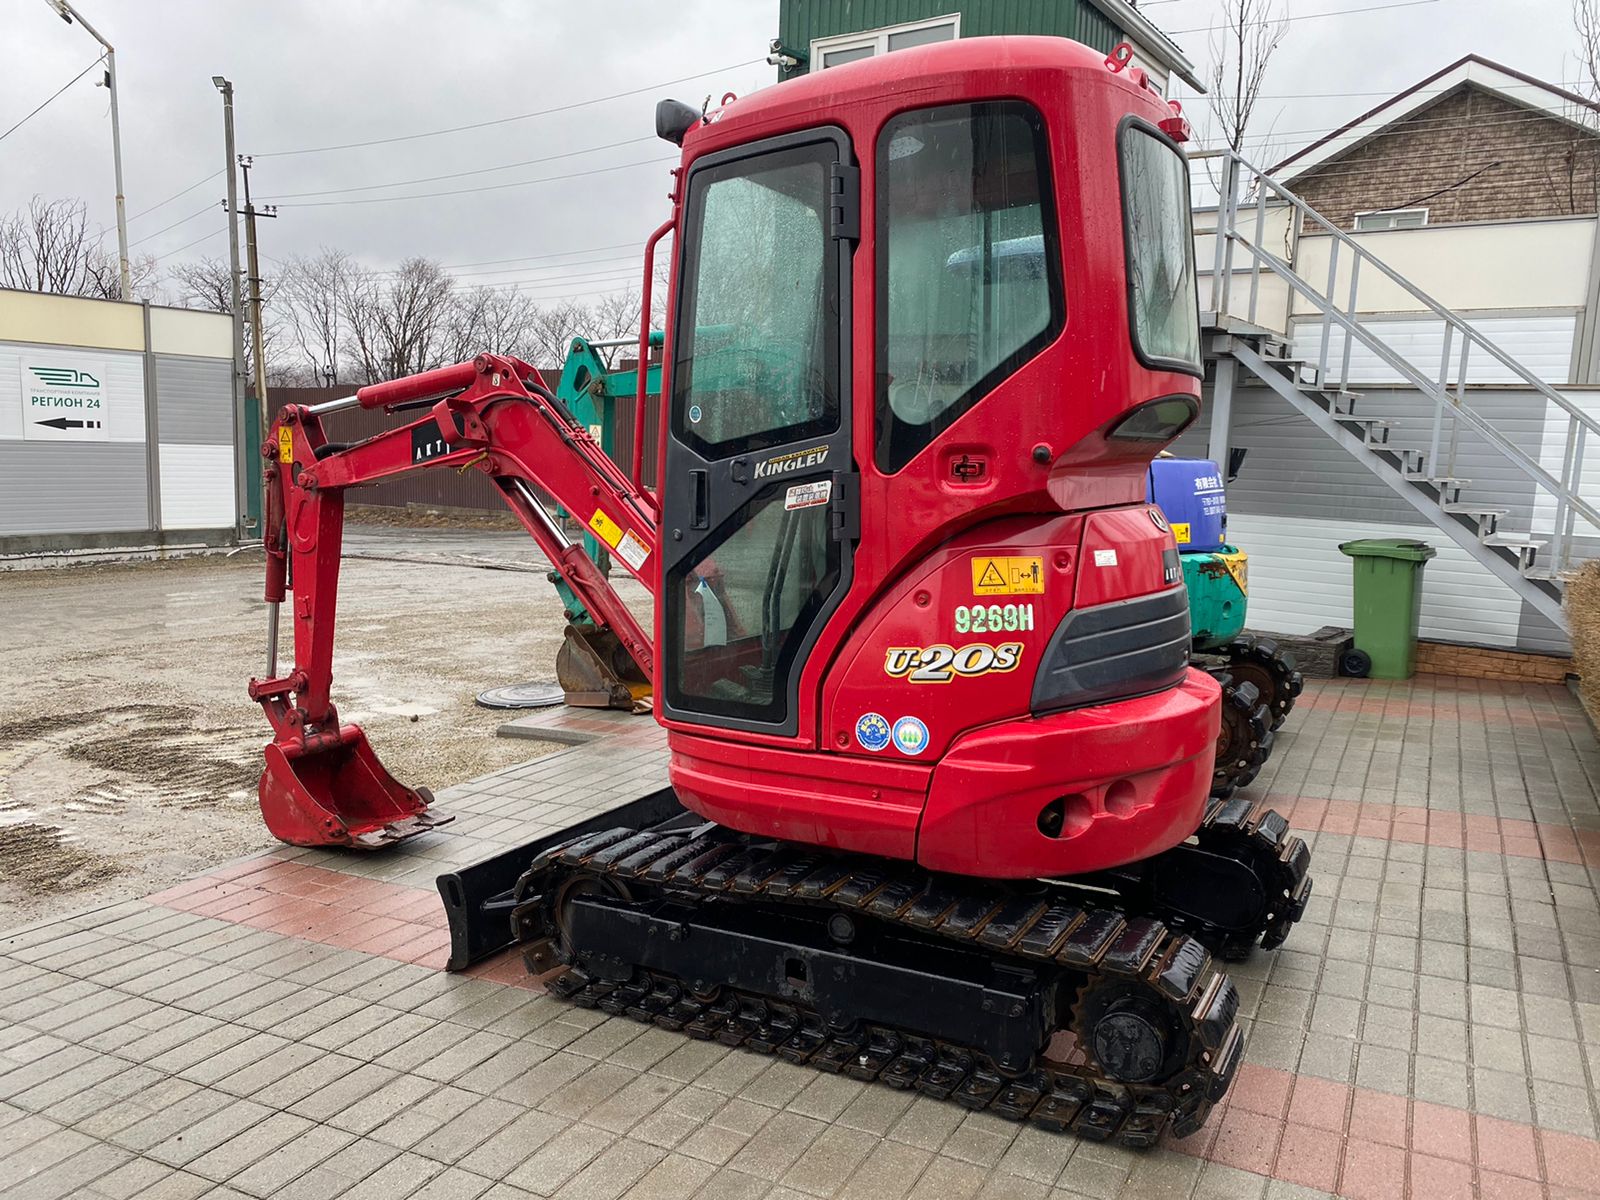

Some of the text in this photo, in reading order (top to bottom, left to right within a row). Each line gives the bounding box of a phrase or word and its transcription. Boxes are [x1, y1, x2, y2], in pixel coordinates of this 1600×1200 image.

[31, 396, 101, 409] РЕГИОН 24
[753, 450, 829, 479] KINGLEV
[955, 603, 1034, 633] 9269H
[886, 643, 1023, 682] U-20S
